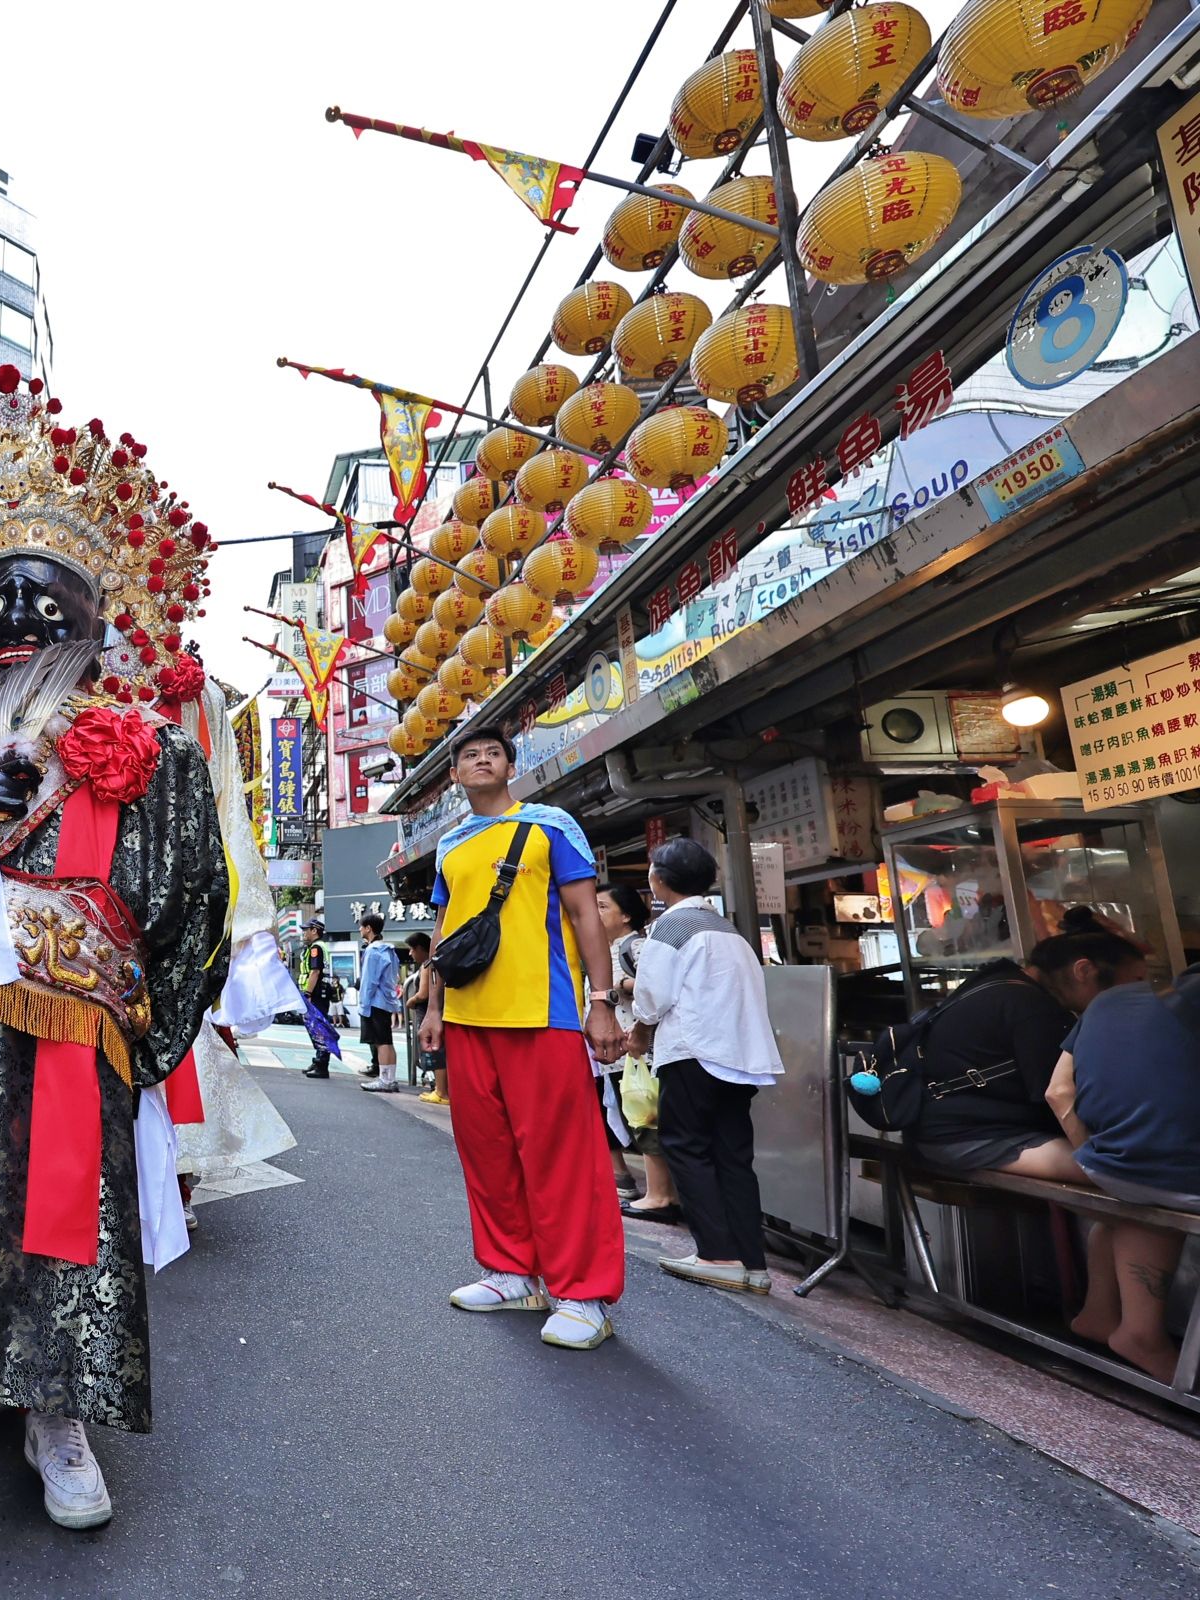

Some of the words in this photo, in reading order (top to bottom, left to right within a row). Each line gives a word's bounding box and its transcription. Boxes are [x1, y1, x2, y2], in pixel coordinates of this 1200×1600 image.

[1036, 275, 1097, 365] 8
[647, 527, 740, 635] 旗魚飯
[785, 349, 955, 528] 鮮魚湯
[1001, 453, 1056, 496] 1950
[711, 610, 748, 643] Rice
[823, 520, 876, 568] Fish
[891, 459, 969, 521] Soup
[591, 662, 605, 700] 6
[1090, 681, 1119, 703] 湯類
[1088, 788, 1100, 803] 15
[1103, 785, 1115, 800] 50
[1117, 783, 1130, 798] 50
[1132, 779, 1145, 794] 90
[1175, 766, 1193, 784] 100
